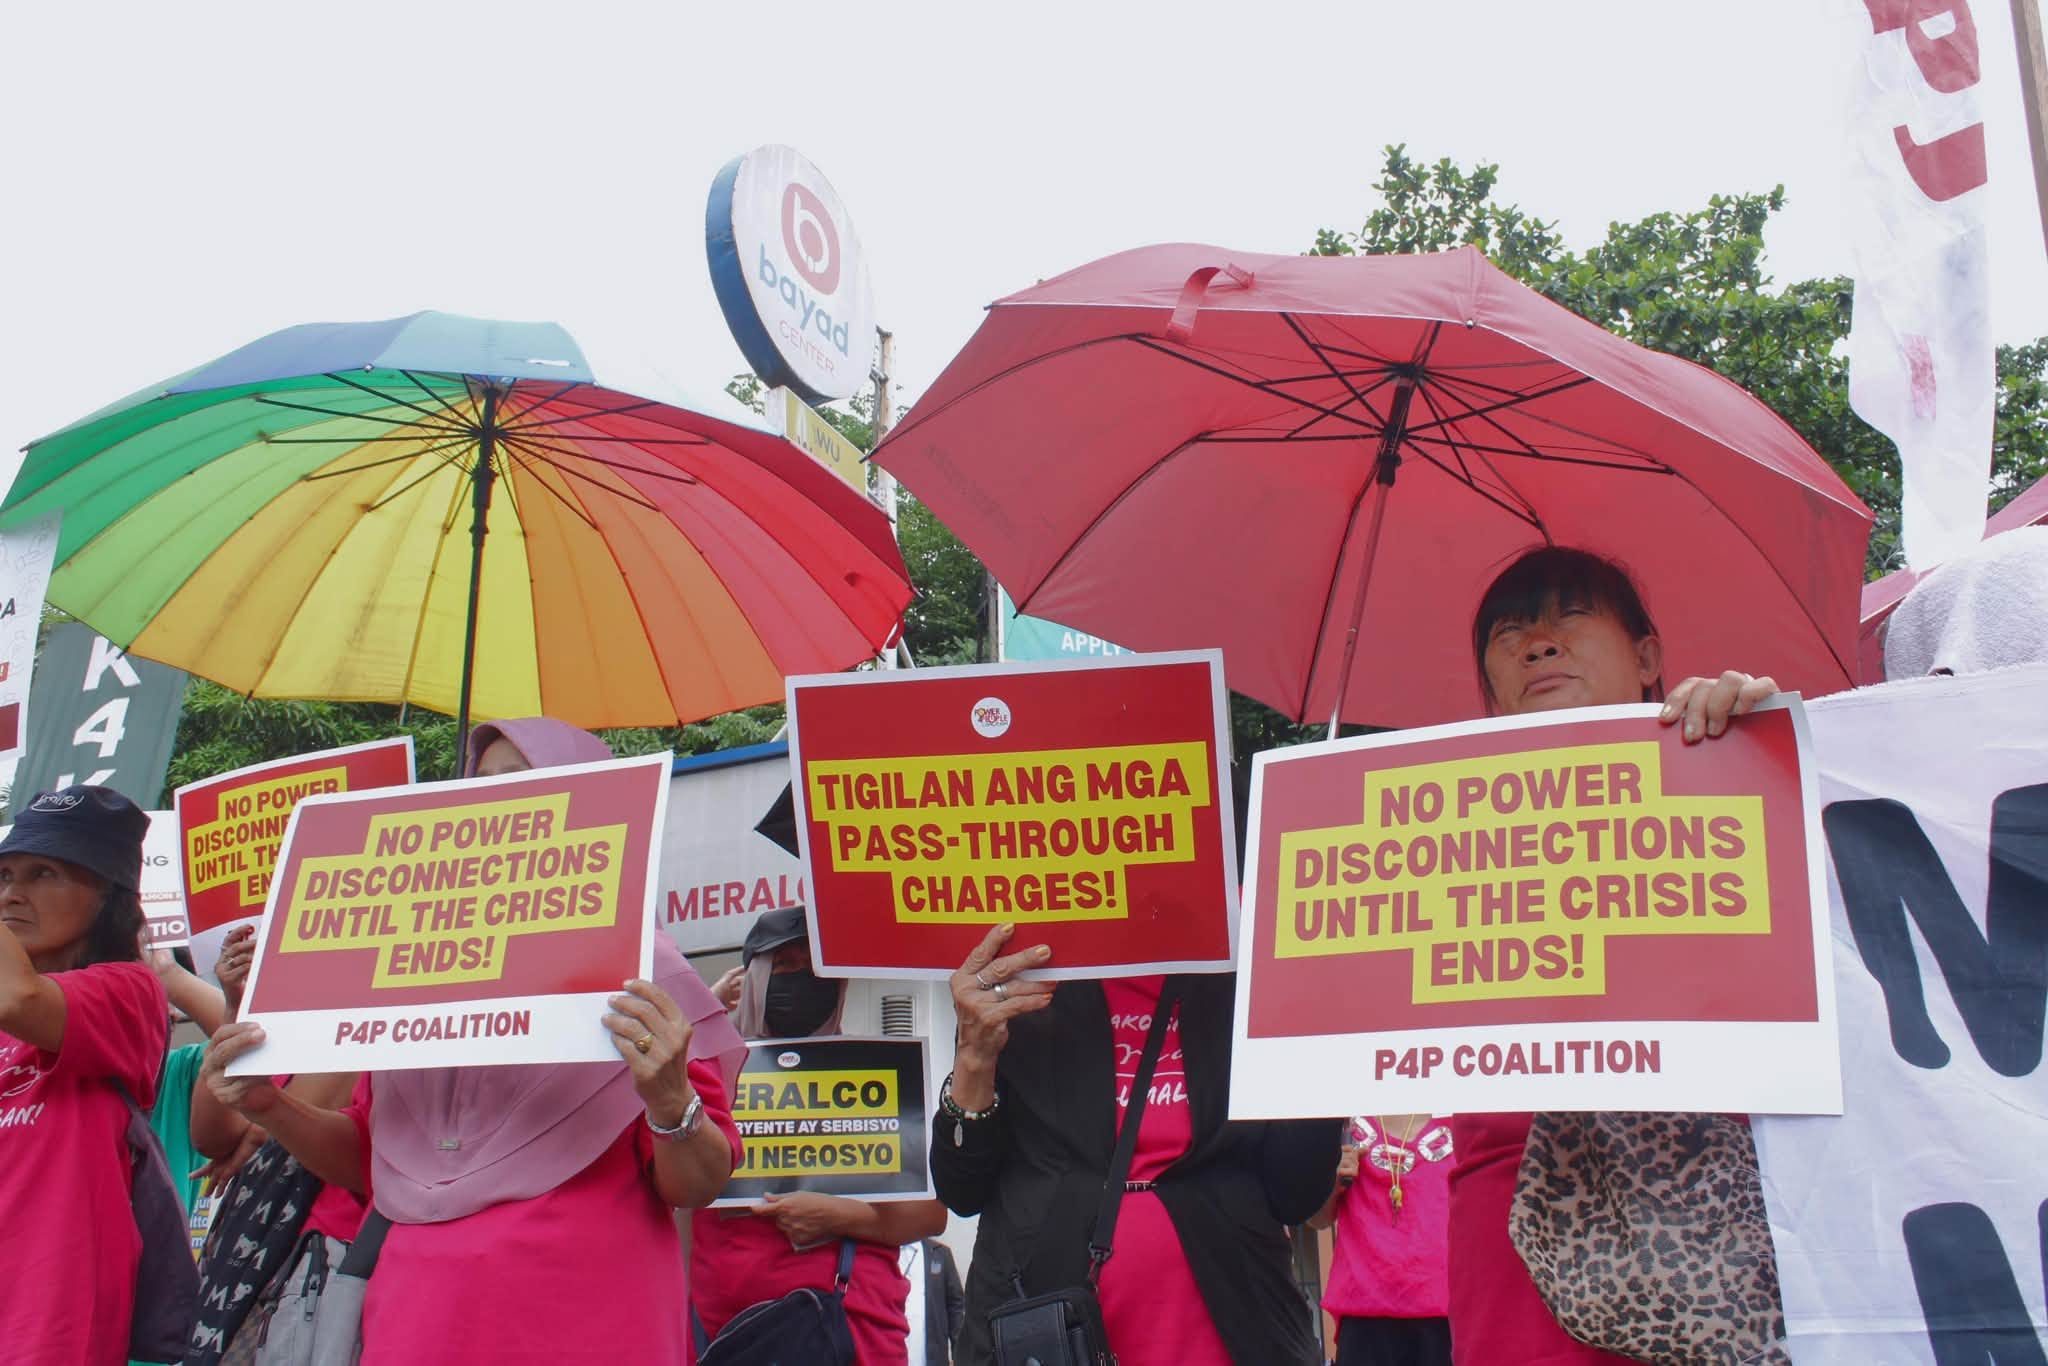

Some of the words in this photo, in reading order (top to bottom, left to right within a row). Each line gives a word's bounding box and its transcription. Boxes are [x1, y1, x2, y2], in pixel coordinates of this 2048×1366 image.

[759, 242, 849, 356] bayad
[779, 319, 835, 377] CENTER
[225, 795, 252, 820] NO
[257, 778, 339, 813] POWER
[817, 769, 974, 810] TIGILAN
[985, 764, 1076, 806] ANG
[1086, 757, 1192, 800] MGA
[1380, 781, 1444, 828] NO
[1457, 761, 1643, 820] POWER
[375, 823, 423, 858] NO
[429, 809, 555, 852] POWER
[837, 812, 1176, 861] PASS-THROUGH
[1294, 815, 1747, 889] DISCONNECTIONS
[195, 850, 248, 885] UNTIL
[253, 843, 281, 868] TH
[247, 871, 273, 897] EN
[304, 841, 611, 901] DISCONNECTIONS
[297, 905, 399, 940] UNTIL
[411, 898, 478, 932] THE
[483, 882, 604, 926] CRISIS
[666, 873, 804, 924] MERAL
[901, 870, 1117, 913] CHARGES!
[1294, 890, 1434, 942] UNTIL
[1447, 878, 1545, 928] THE
[1559, 871, 1748, 921] CRISIS
[147, 920, 185, 937] TIO
[387, 935, 496, 977] ENDS!
[1430, 933, 1585, 987] ENDS!
[335, 1018, 388, 1046] P4P
[392, 1010, 531, 1042] COALITION
[1375, 1046, 1444, 1081] P4P
[1452, 1040, 1661, 1078] COALITION
[0, 1102, 45, 1128] AN!
[733, 1080, 887, 1111] ERALCO
[735, 1120, 795, 1135] RYENTE
[798, 1120, 820, 1134] AY
[821, 1118, 900, 1133] SERBISYO
[762, 1142, 893, 1169] NEGOSYO
